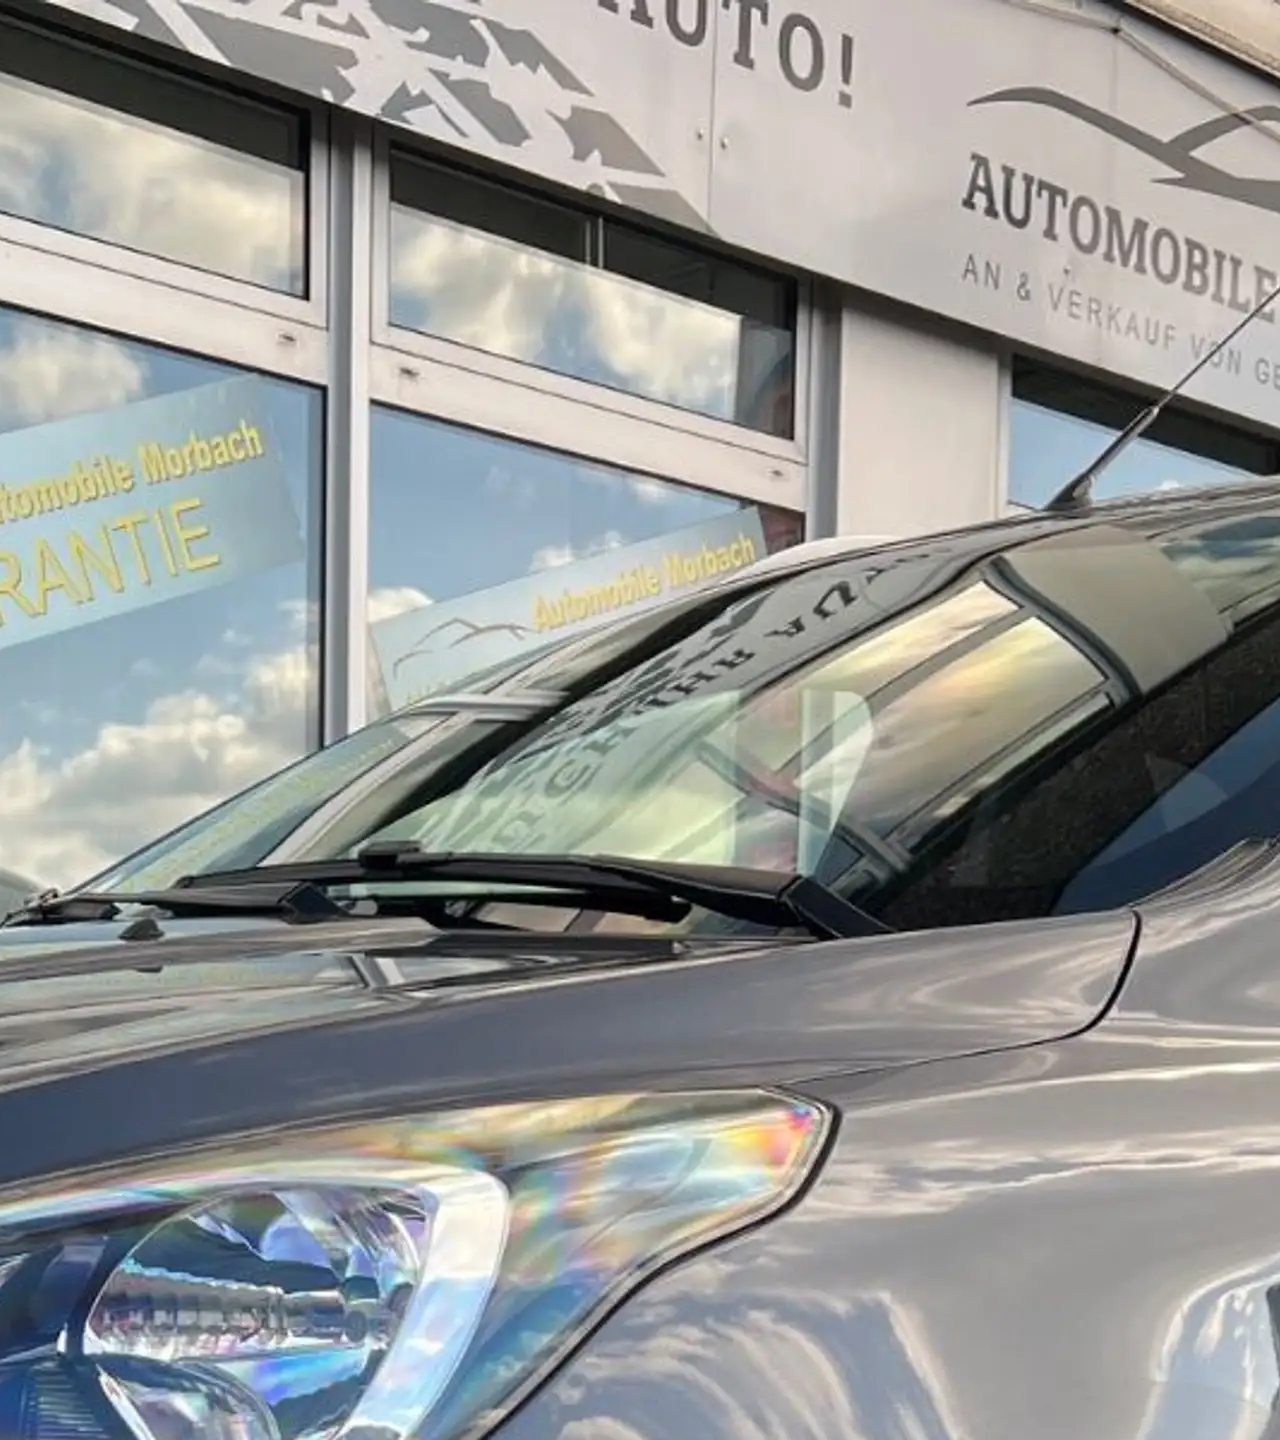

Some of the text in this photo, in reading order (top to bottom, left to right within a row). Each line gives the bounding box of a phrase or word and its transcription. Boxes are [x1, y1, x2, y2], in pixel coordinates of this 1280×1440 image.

[962, 153, 1277, 324] AUTOMOBILE
[962, 253, 1001, 291] AN
[1015, 271, 1032, 302] &
[1047, 281, 1177, 350] VERKAUF
[1189, 331, 1242, 376] VON
[139, 418, 266, 485] Morbach
[532, 533, 756, 633] Automobile Morbach
